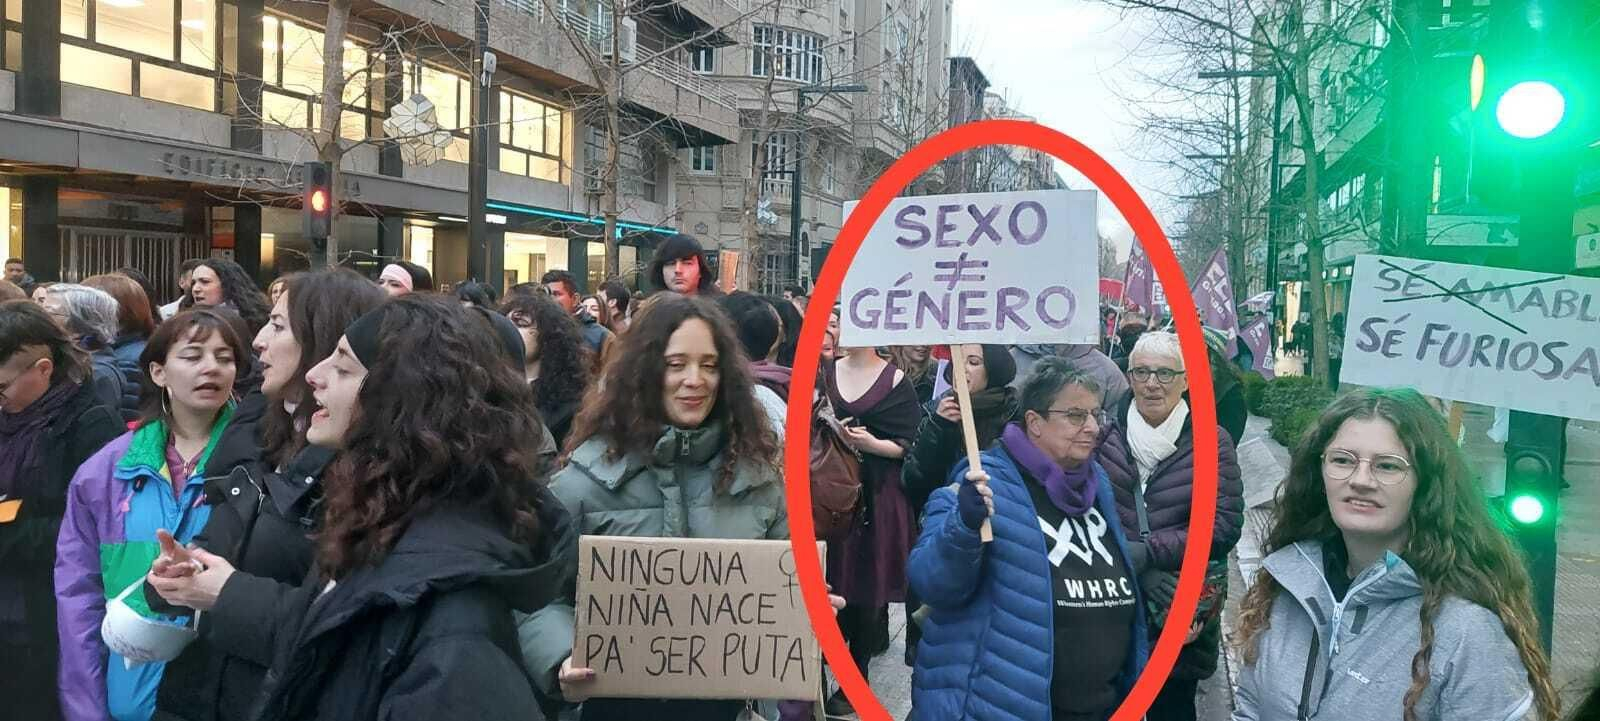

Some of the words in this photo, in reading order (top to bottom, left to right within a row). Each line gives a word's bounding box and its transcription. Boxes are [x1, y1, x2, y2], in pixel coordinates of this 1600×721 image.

[894, 200, 1048, 249] SEXO
[849, 272, 1076, 332] GÉNERO
[1373, 263, 1435, 297] SÉ
[1441, 277, 1600, 323] AMABL
[1356, 313, 1411, 359] SÉ
[1416, 322, 1600, 387] FURIOSA
[590, 547, 747, 585] NINGUNA
[1063, 577, 1132, 599] WHRC
[587, 587, 674, 627] NIÑA
[690, 592, 777, 625] NACE
[585, 634, 634, 674] PA'
[645, 635, 707, 677] SER
[722, 632, 806, 682] PUTA
